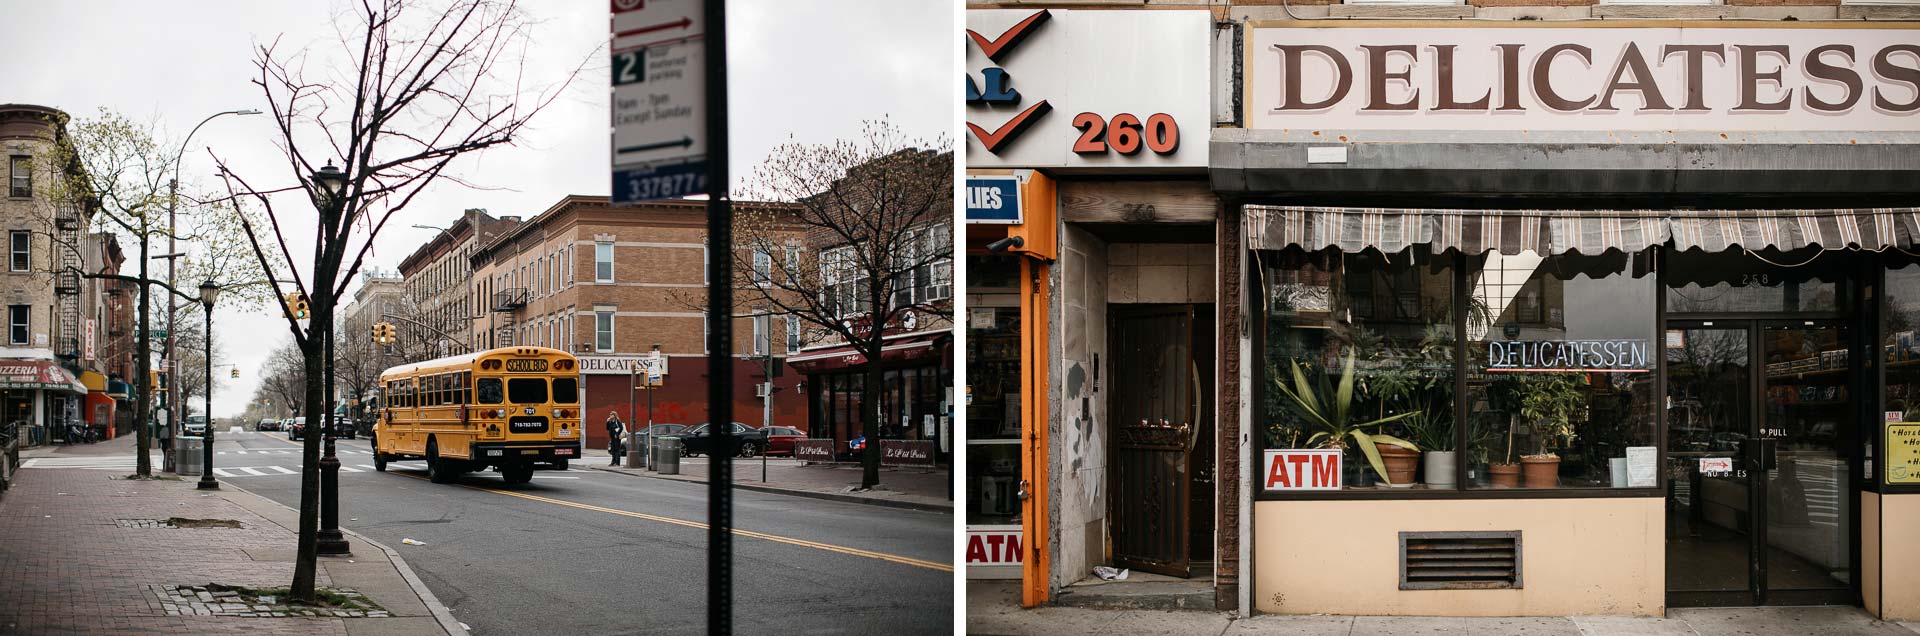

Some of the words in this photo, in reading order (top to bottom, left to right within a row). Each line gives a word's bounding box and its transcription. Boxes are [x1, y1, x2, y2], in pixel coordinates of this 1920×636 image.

[618, 52, 638, 83] 2
[617, 110, 650, 126] Except
[654, 104, 692, 120] Sunday
[1072, 112, 1180, 155] 260
[508, 359, 533, 371] SCHOOL
[534, 359, 547, 371] BUS
[1488, 341, 1646, 367] DELICATESSEN
[1768, 428, 1787, 436] PULL
[910, 450, 927, 459] Paris
[1266, 455, 1338, 488] ATM
